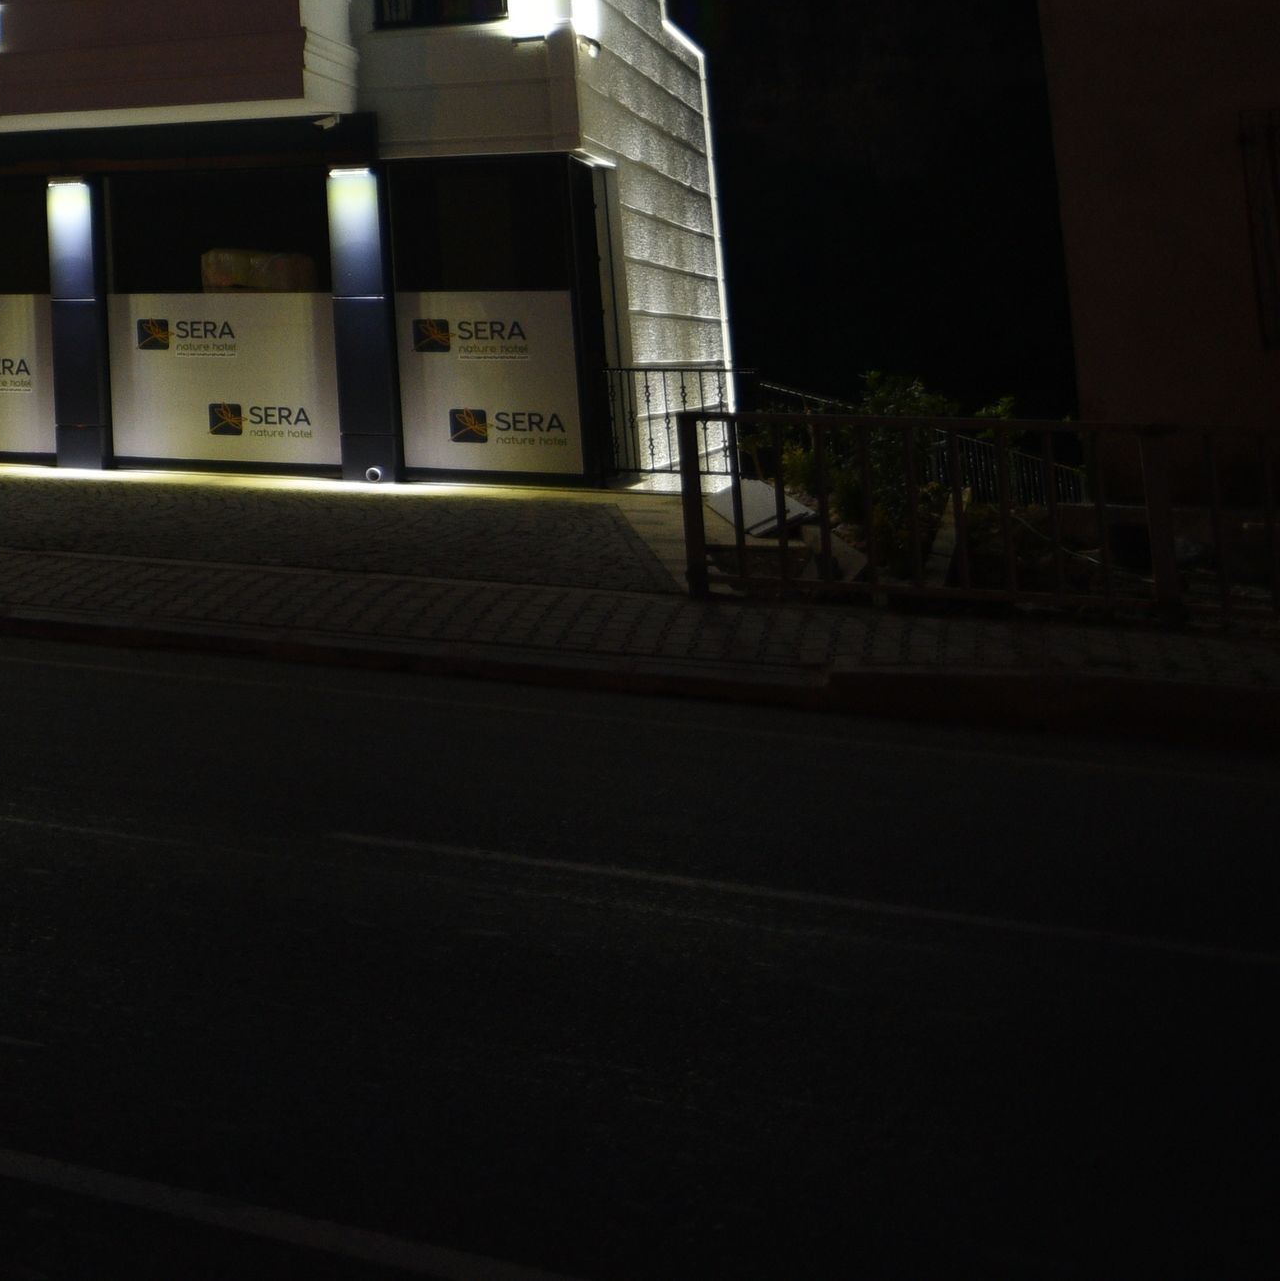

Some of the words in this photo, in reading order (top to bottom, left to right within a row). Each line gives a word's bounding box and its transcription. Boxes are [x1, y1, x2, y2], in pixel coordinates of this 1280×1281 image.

[175, 320, 235, 339] SERA
[458, 321, 527, 341] SERA
[176, 342, 210, 351] nature
[212, 341, 237, 352] hotel
[459, 344, 497, 353] nature
[500, 343, 528, 354] hotel
[10, 378, 32, 388] hotel
[249, 406, 312, 426] SERA
[495, 412, 566, 433] SERA
[249, 428, 284, 438] nature
[287, 428, 312, 439] hotel
[496, 436, 535, 446] nature
[539, 435, 568, 448] hotel
